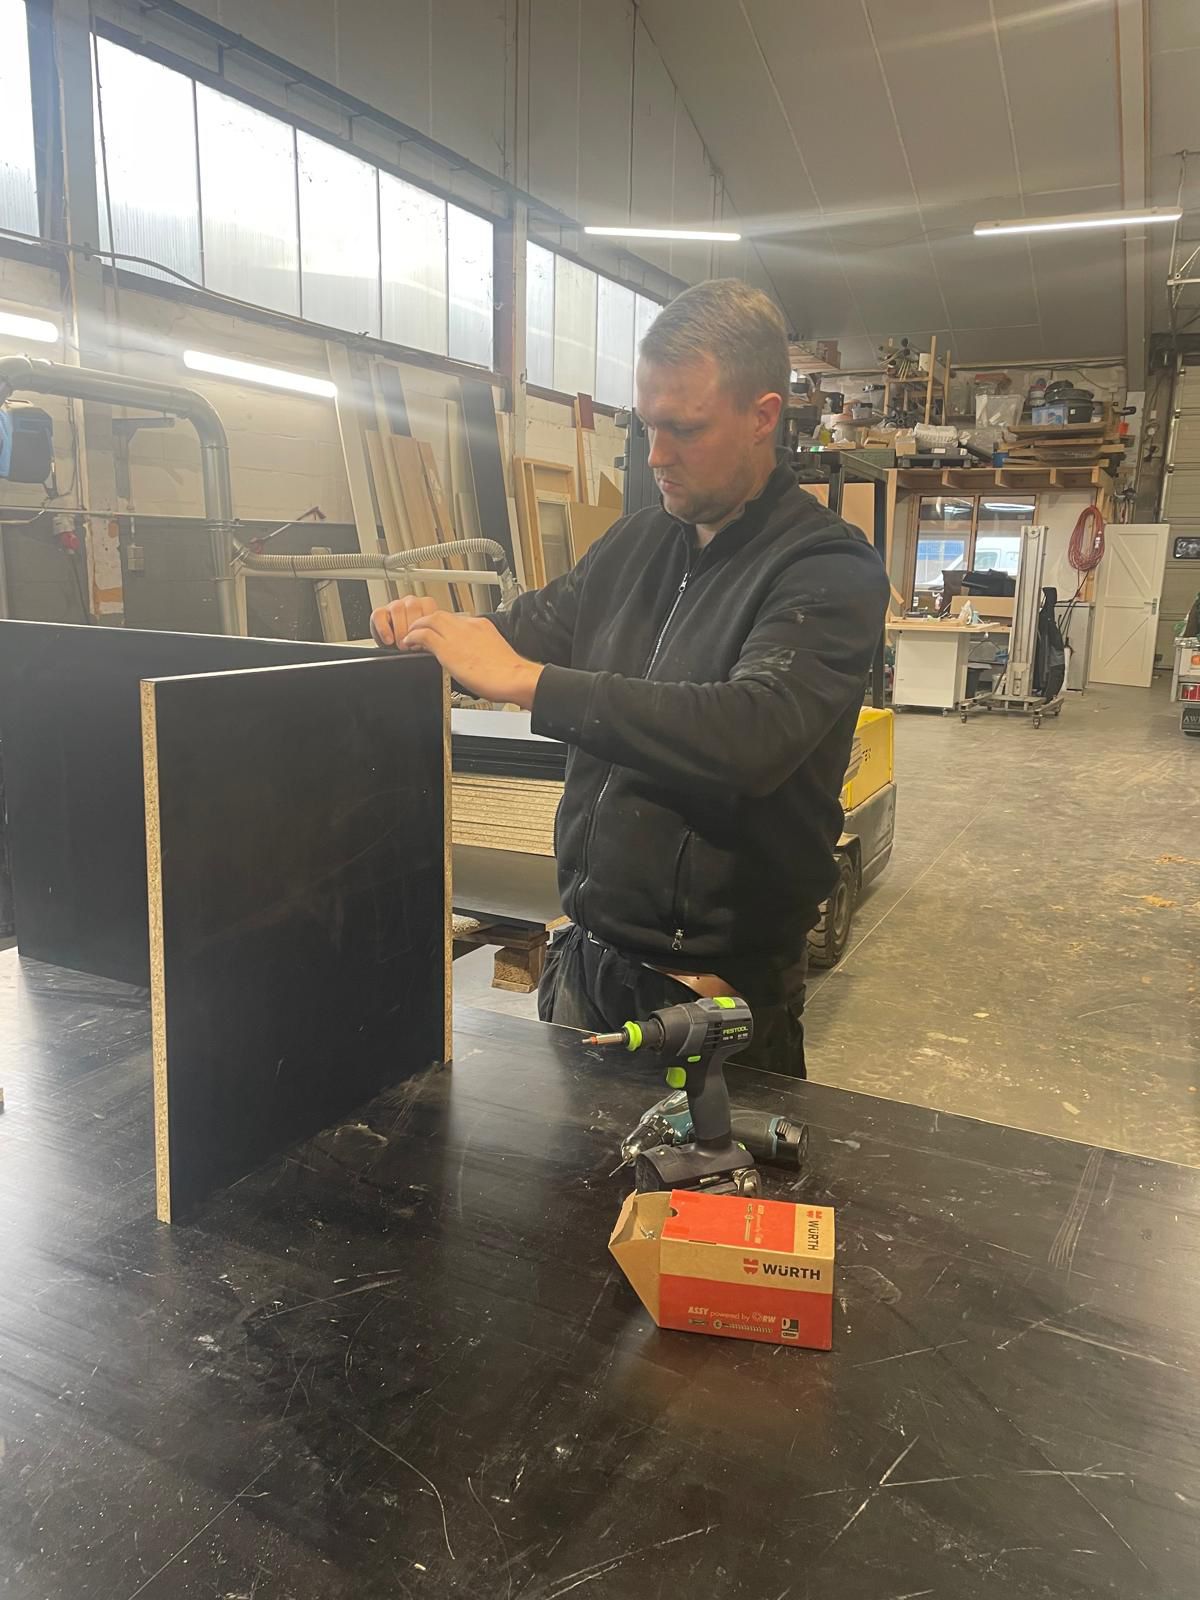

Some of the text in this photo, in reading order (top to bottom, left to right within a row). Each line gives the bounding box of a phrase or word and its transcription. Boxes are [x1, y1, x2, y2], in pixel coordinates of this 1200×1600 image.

[722, 1026, 749, 1034] FESTOOL
[808, 1220, 820, 1251] WÜRTH
[763, 1263, 820, 1280] WÜRTH
[710, 1311, 740, 1321] powered
[741, 1312, 750, 1322] by
